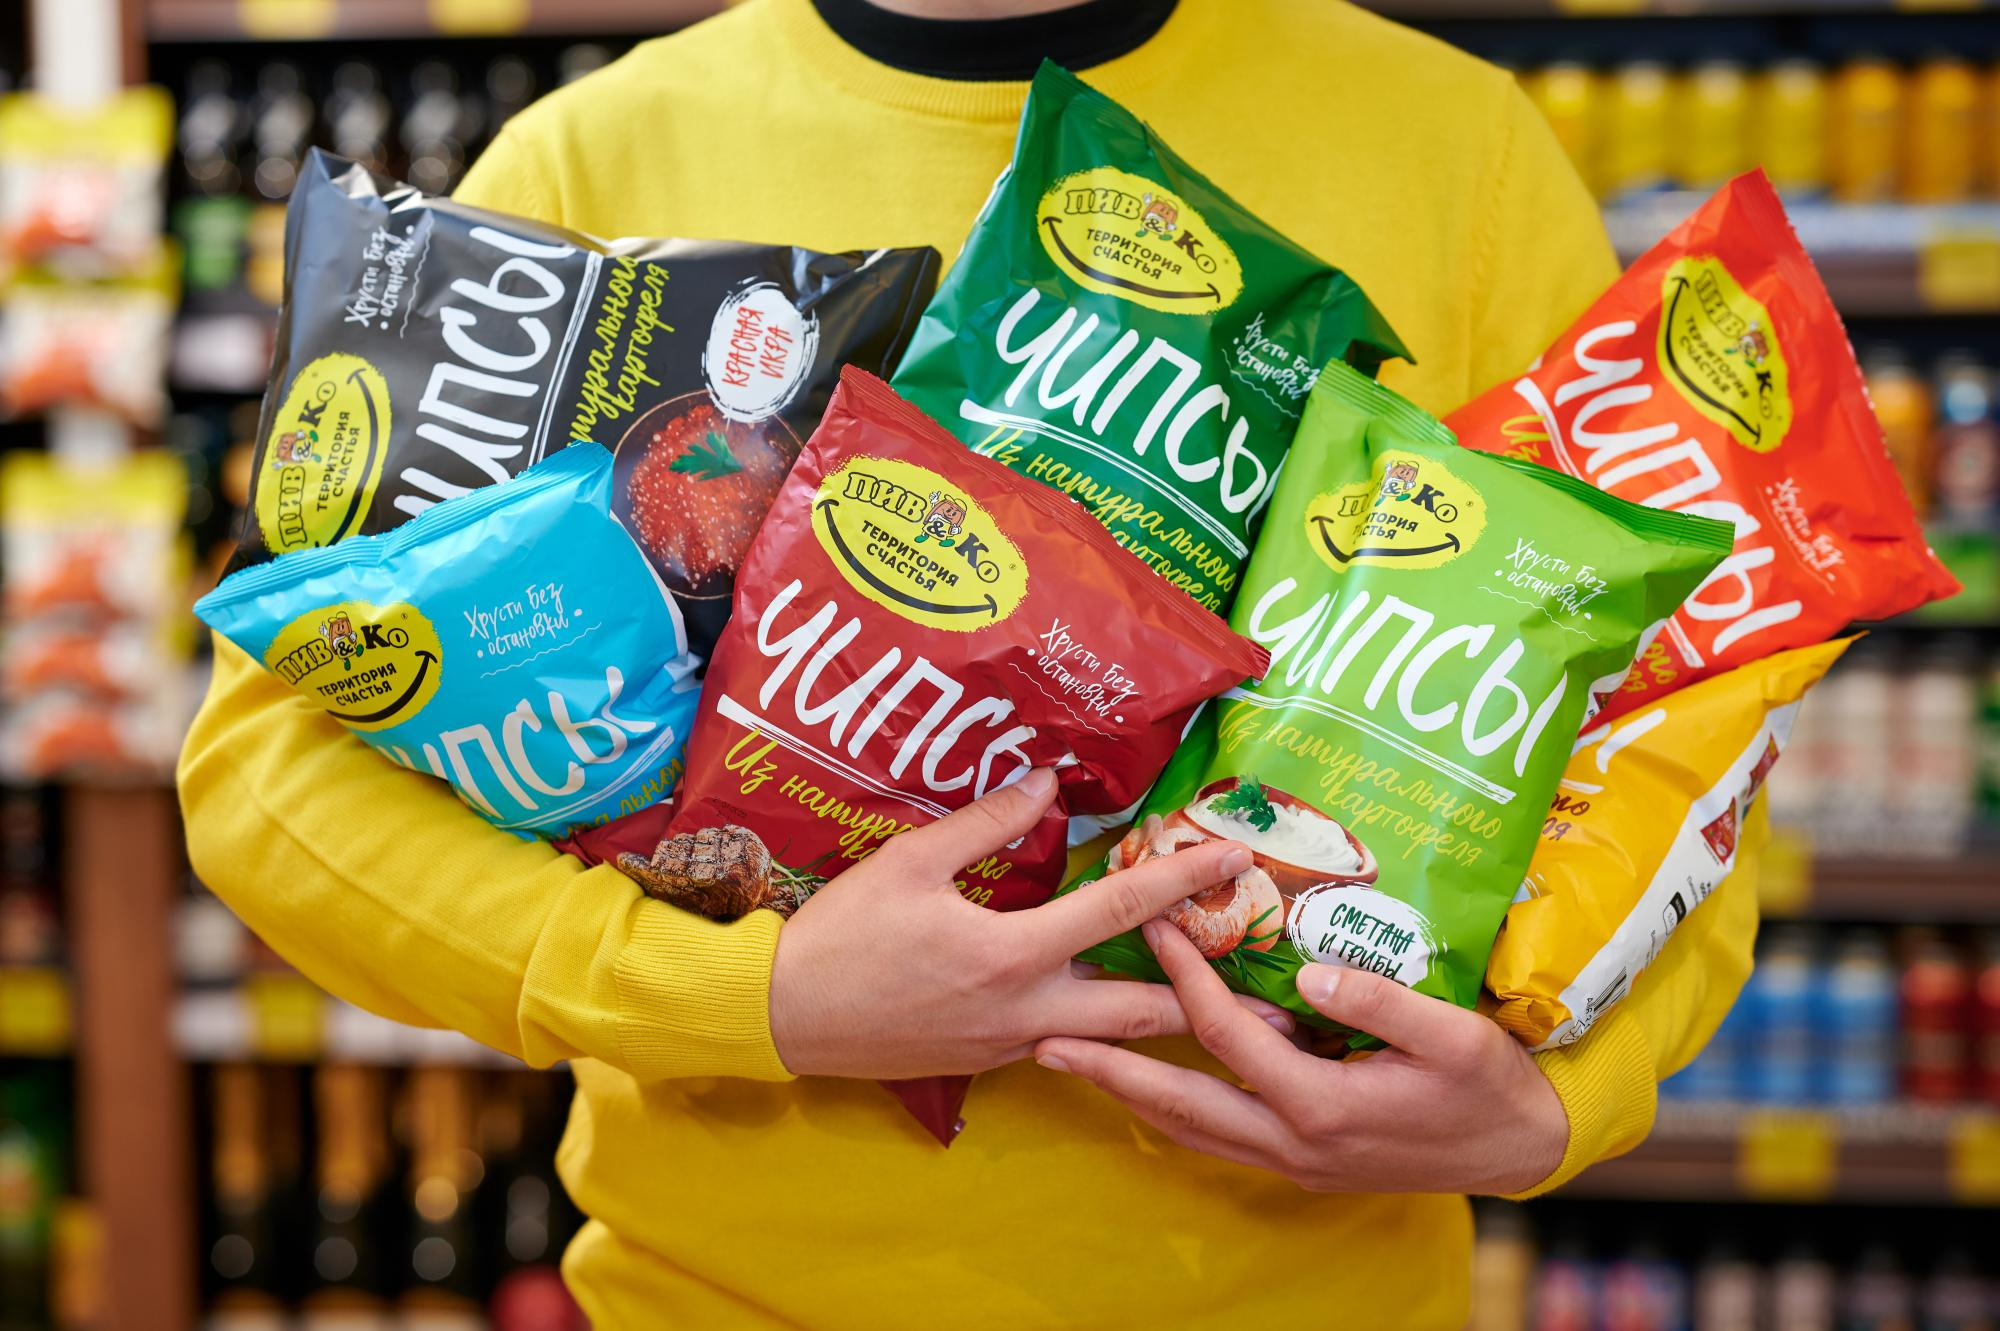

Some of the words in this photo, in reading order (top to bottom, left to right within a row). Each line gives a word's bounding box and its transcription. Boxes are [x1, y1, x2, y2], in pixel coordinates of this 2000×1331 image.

[380, 238, 415, 317] остановки
[1087, 228, 1182, 275] ТЕРРИТОРИЯ
[1093, 245, 1162, 280] СЧАСТЬЯ
[344, 266, 381, 327] Хрусти
[612, 263, 675, 412] картофеля
[722, 306, 764, 387] КРАСНАЯ
[760, 325, 794, 379] ИКРА
[1245, 312, 1289, 362] Хрусти
[1681, 336, 1730, 393] СЧАСТЬЯ
[1686, 315, 1749, 399] ТЕРРИТОРИЯ
[1236, 345, 1301, 400] остановки
[317, 411, 350, 512] ТЕРРИТОРИЯ
[333, 427, 360, 497] СЧАСТЬЯ
[1026, 453, 1238, 592] натурального
[861, 520, 960, 587] ТЕРРИТОРИЯ
[866, 542, 938, 592] СЧАСТЬЯ
[1102, 522, 1221, 613] артофеля
[1505, 537, 1570, 572] Хрусти
[463, 601, 523, 640] Хрусти
[1507, 571, 1580, 616] остановки
[487, 612, 569, 655] остановки
[1040, 617, 1101, 673] Хрусти
[316, 662, 398, 696] ТЕРРИТОРИЯ
[336, 680, 393, 706] СЧАСТЬЯ
[1038, 655, 1111, 717] остановки
[724, 728, 778, 794] Из
[1219, 700, 1264, 753] Из
[1260, 722, 1503, 839] натурального
[1323, 783, 1484, 867] картофеля
[1318, 933, 1338, 954] И
[1338, 940, 1403, 980] ГРИБЫ
[1330, 903, 1416, 956] СМЕТАНА
